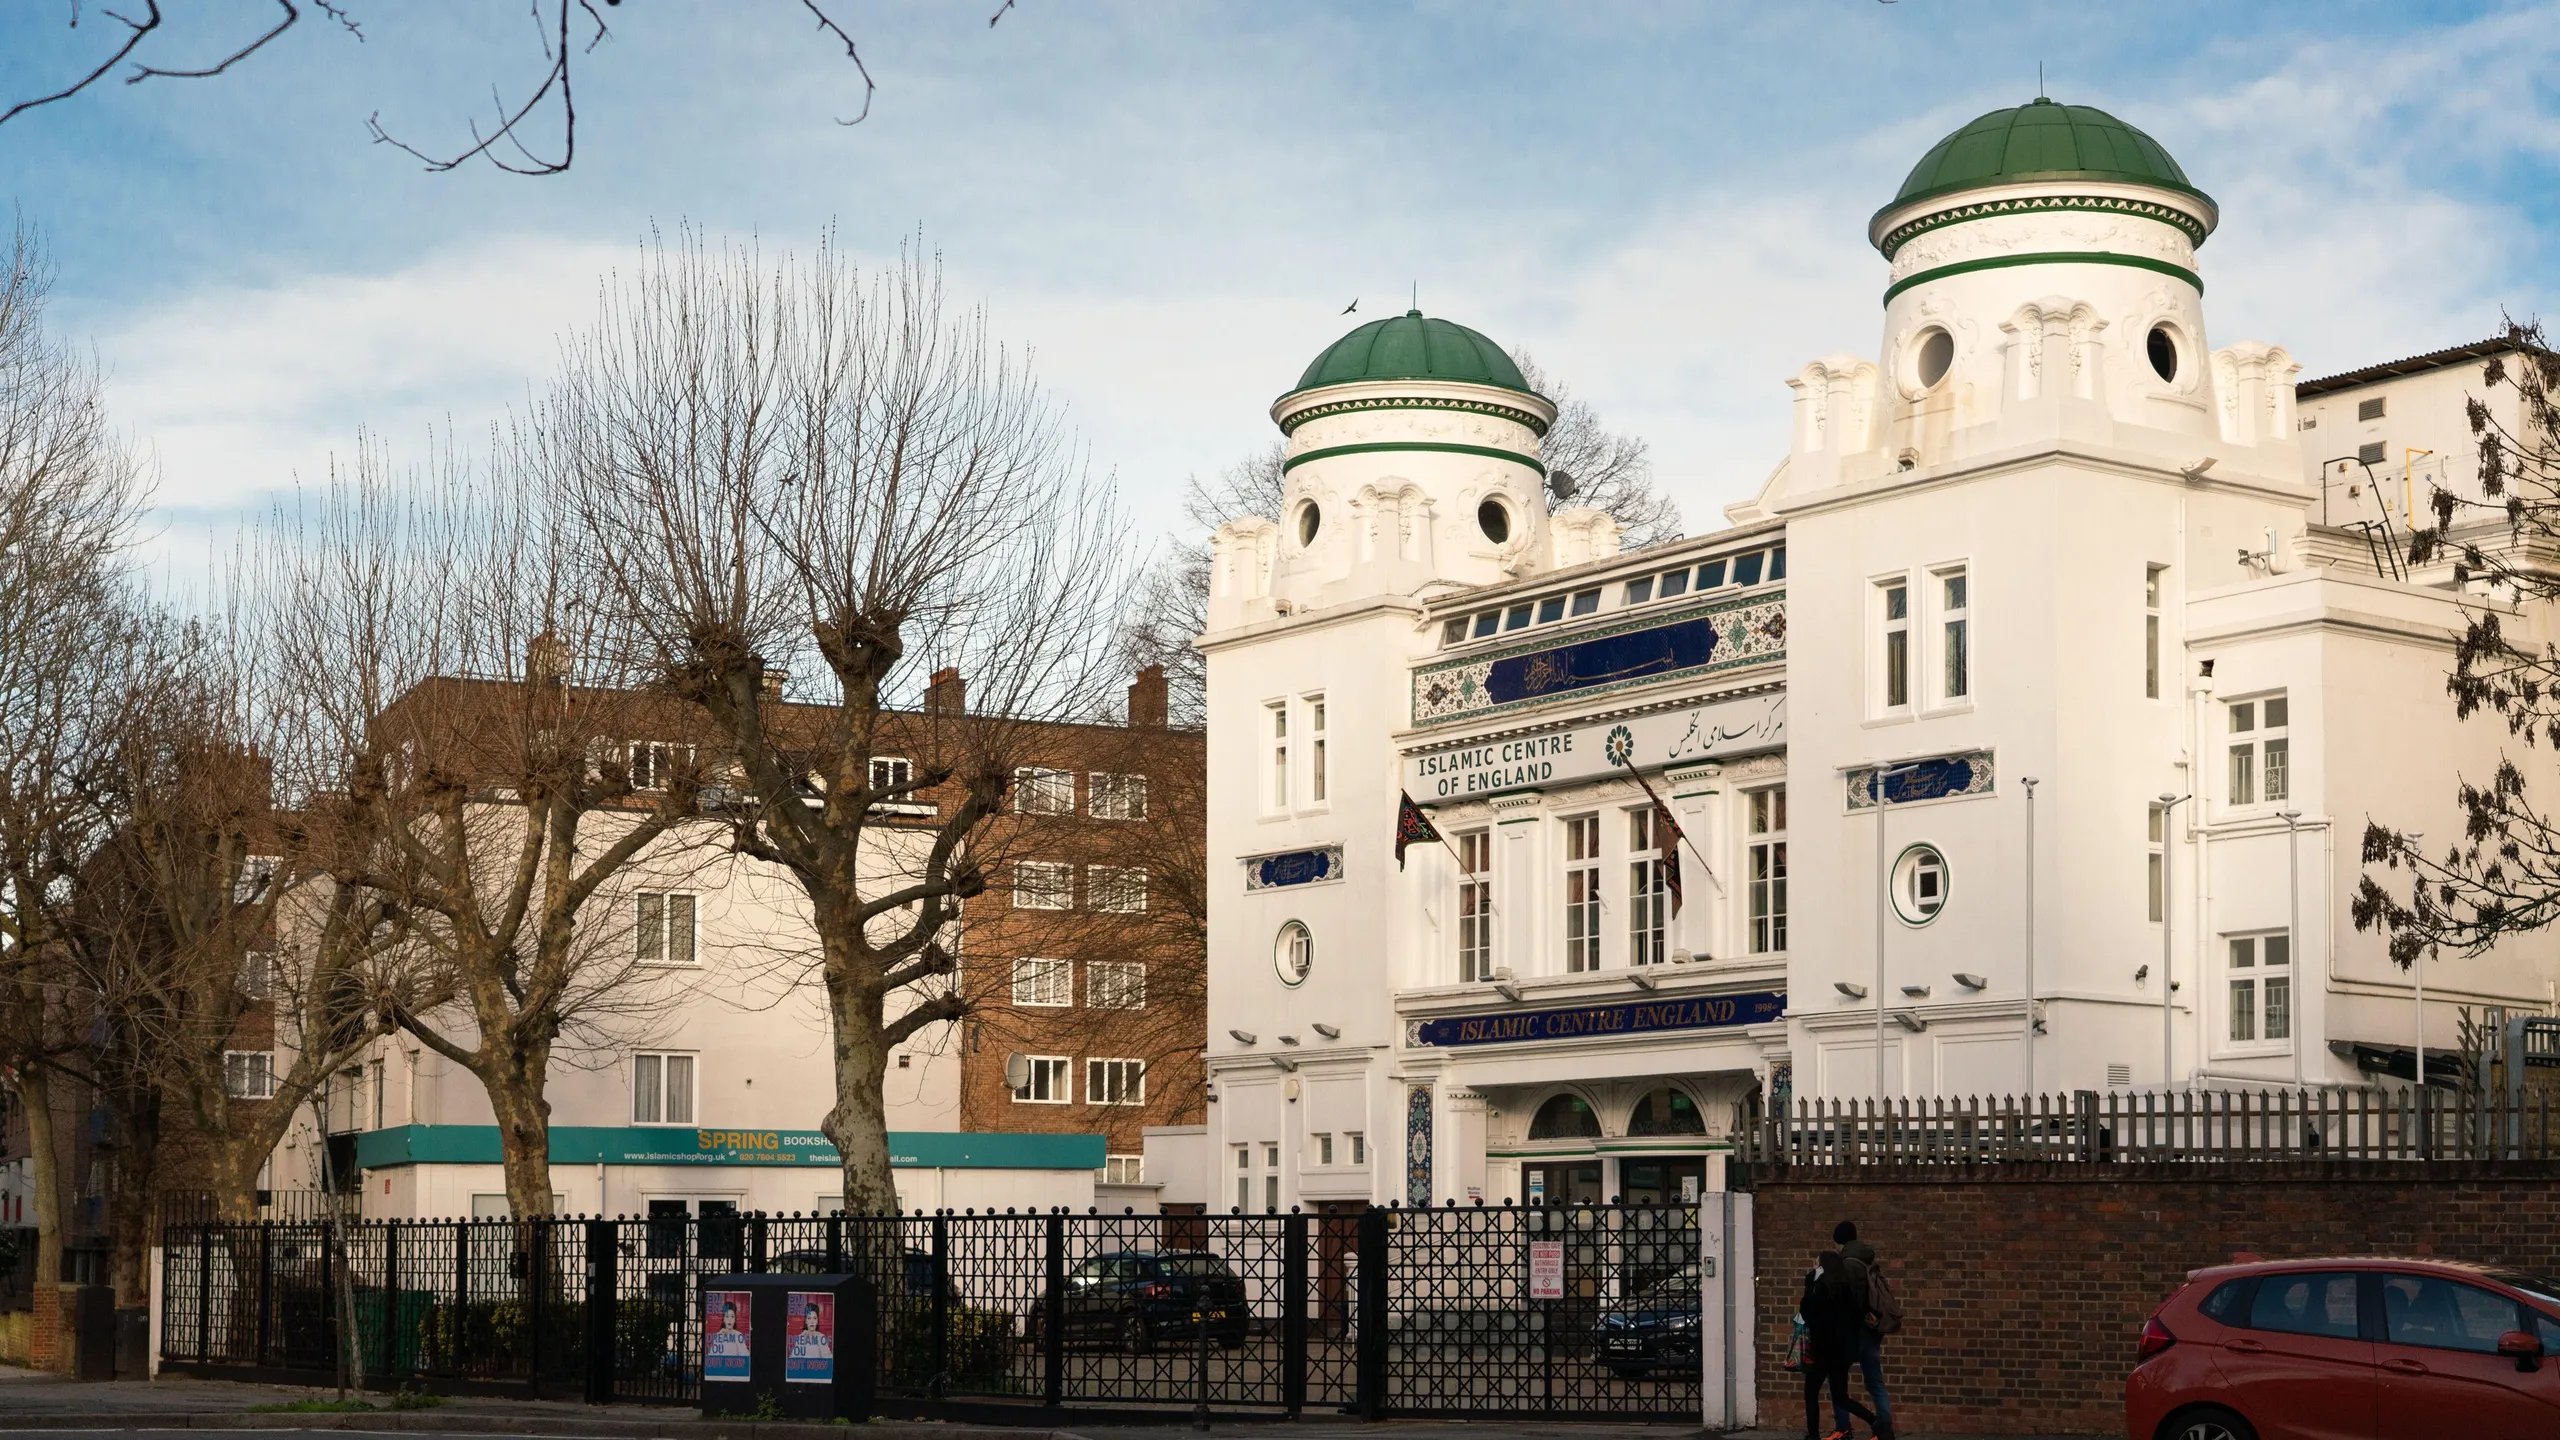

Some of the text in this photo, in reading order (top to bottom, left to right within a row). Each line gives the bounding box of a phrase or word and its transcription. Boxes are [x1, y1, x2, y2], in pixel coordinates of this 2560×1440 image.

[1419, 734, 1573, 776] ISLAMIC CENTRE
[1438, 762, 1552, 796] OF ENGLAND
[1459, 1015, 1540, 1042] ISLAMIC
[1545, 1008, 1625, 1035] CENTRE
[1632, 999, 1736, 1028] ENGLAND
[699, 1132, 834, 1150] SPRING BOOKSHO
[706, 1333, 750, 1344] DREAM OF
[789, 1335, 833, 1346] DREAM OF
[706, 1343, 724, 1354] YOU
[789, 1346, 806, 1356] YOU
